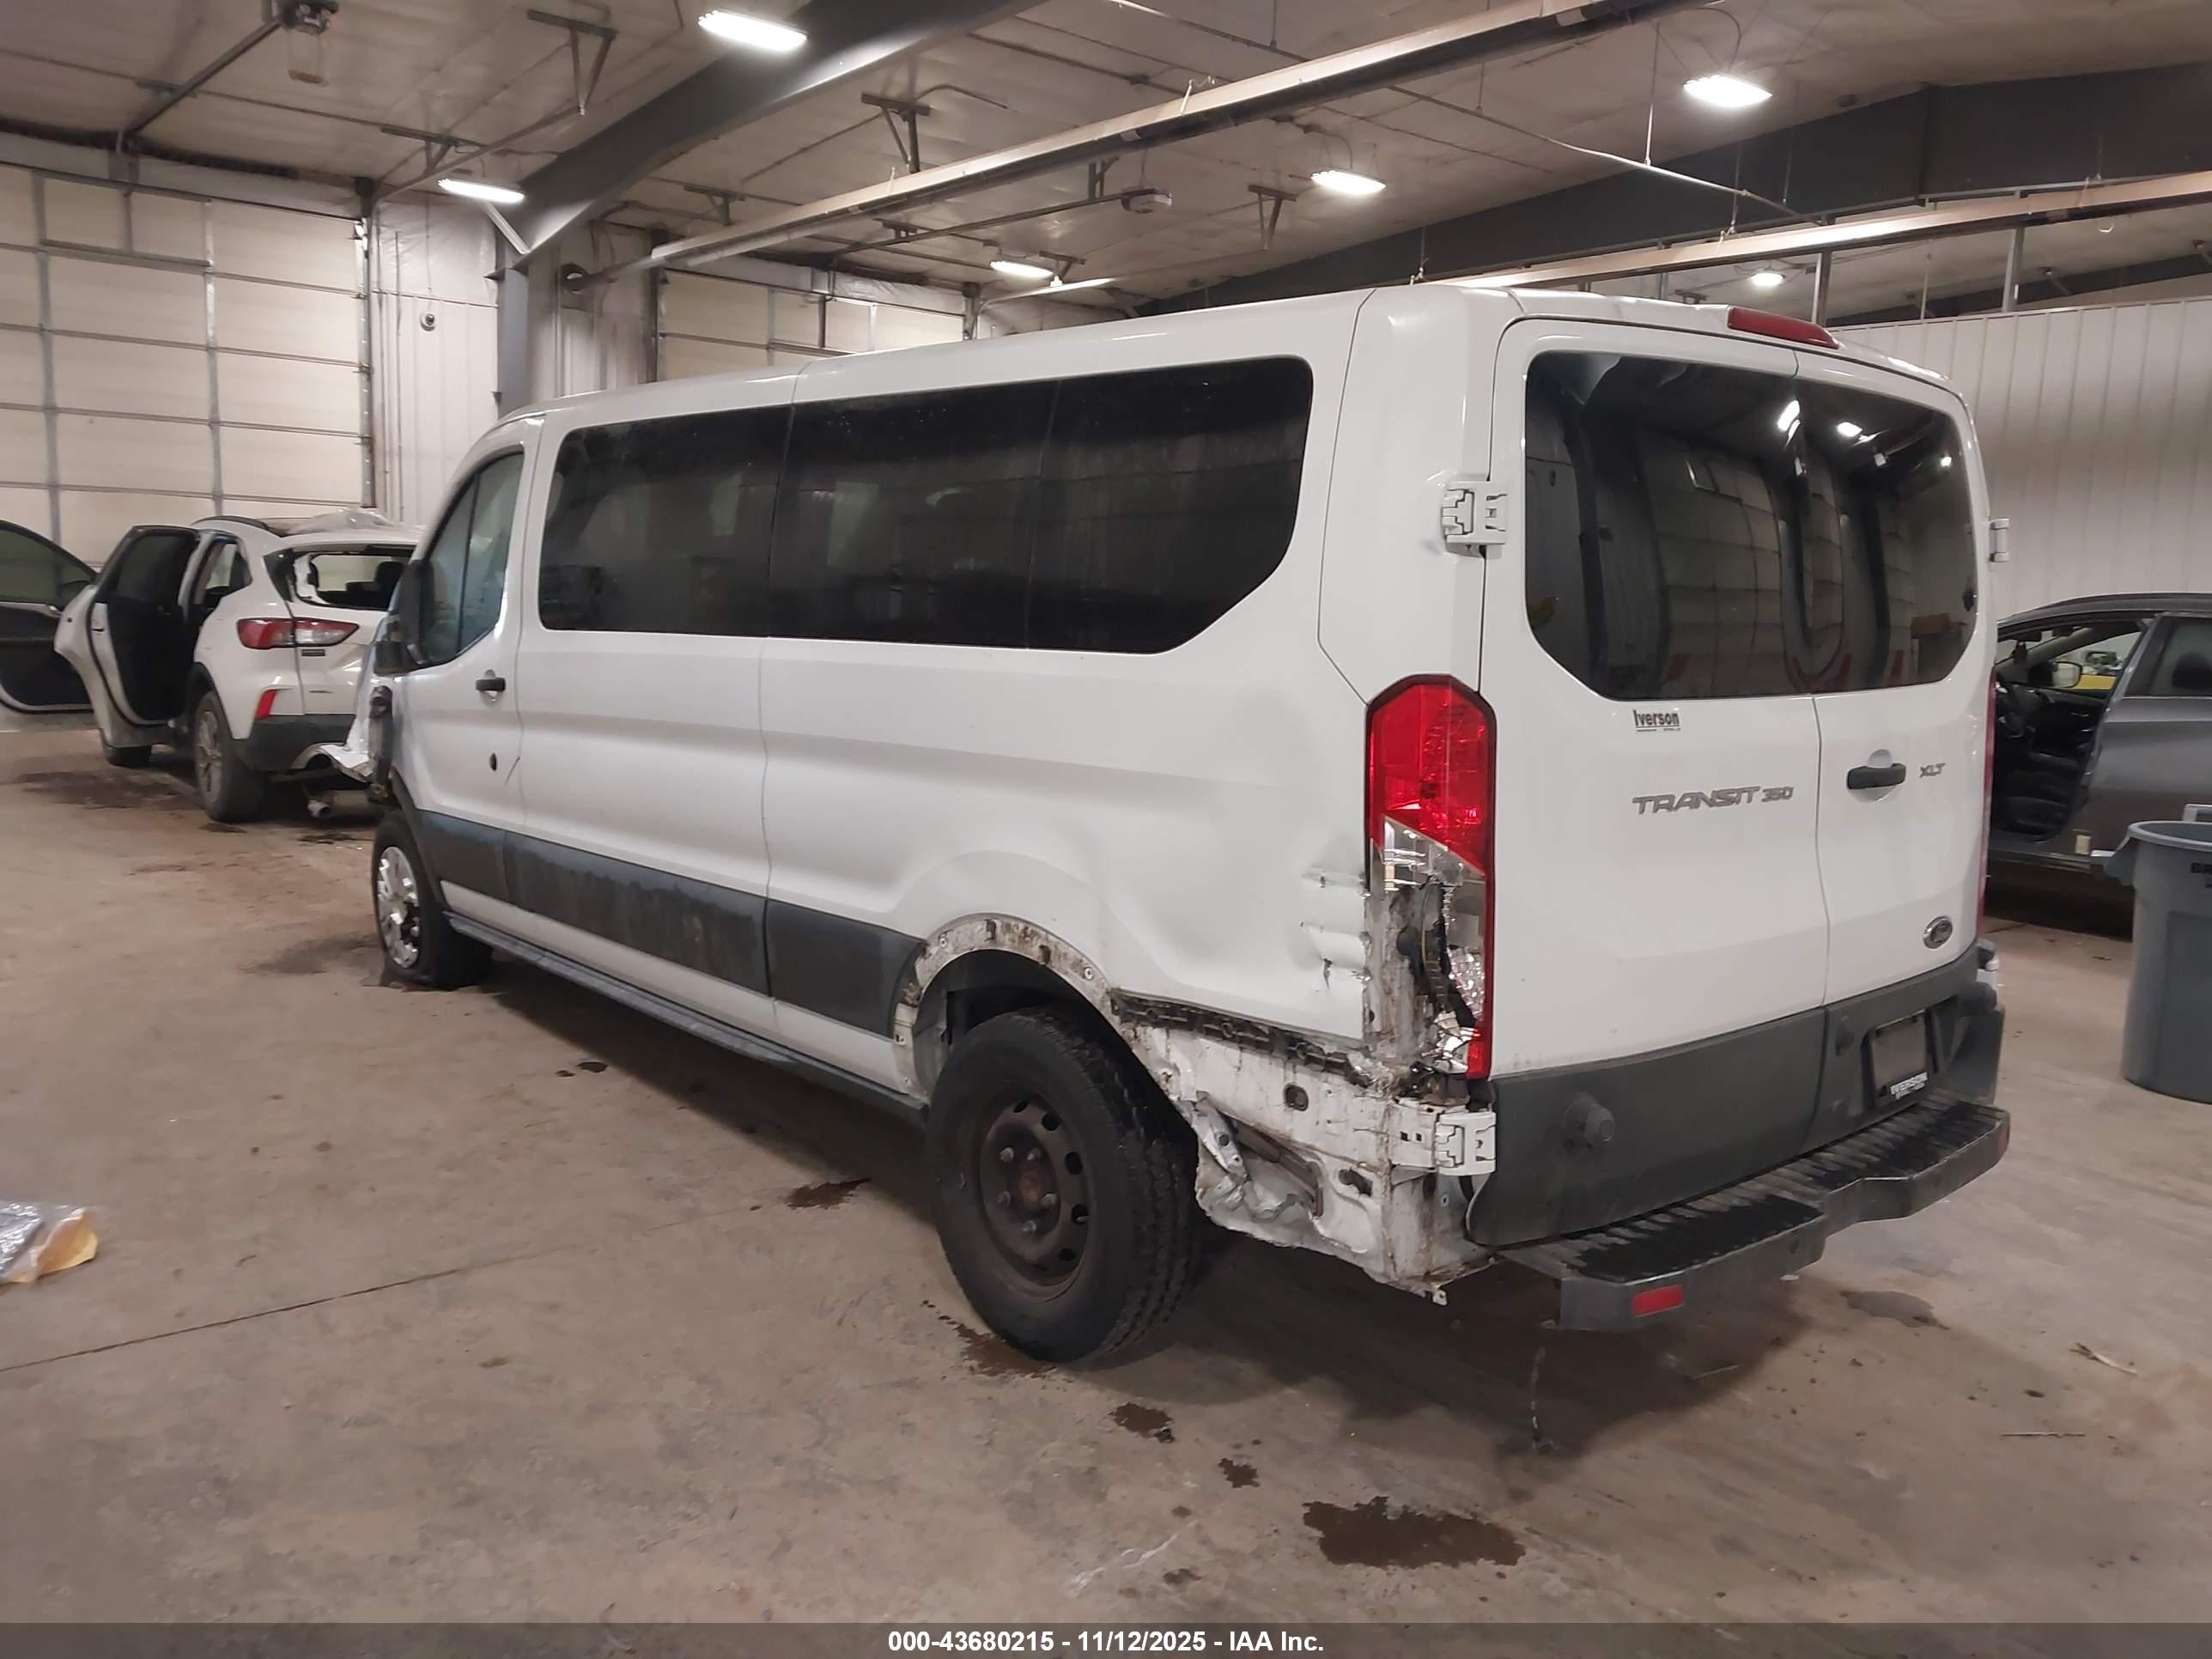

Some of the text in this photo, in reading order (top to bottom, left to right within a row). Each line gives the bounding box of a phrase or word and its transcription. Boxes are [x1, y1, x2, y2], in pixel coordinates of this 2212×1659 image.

[1633, 709, 1680, 726] Iverson
[1919, 763, 1947, 778] XLT
[1632, 786, 1761, 815] TRANSIT
